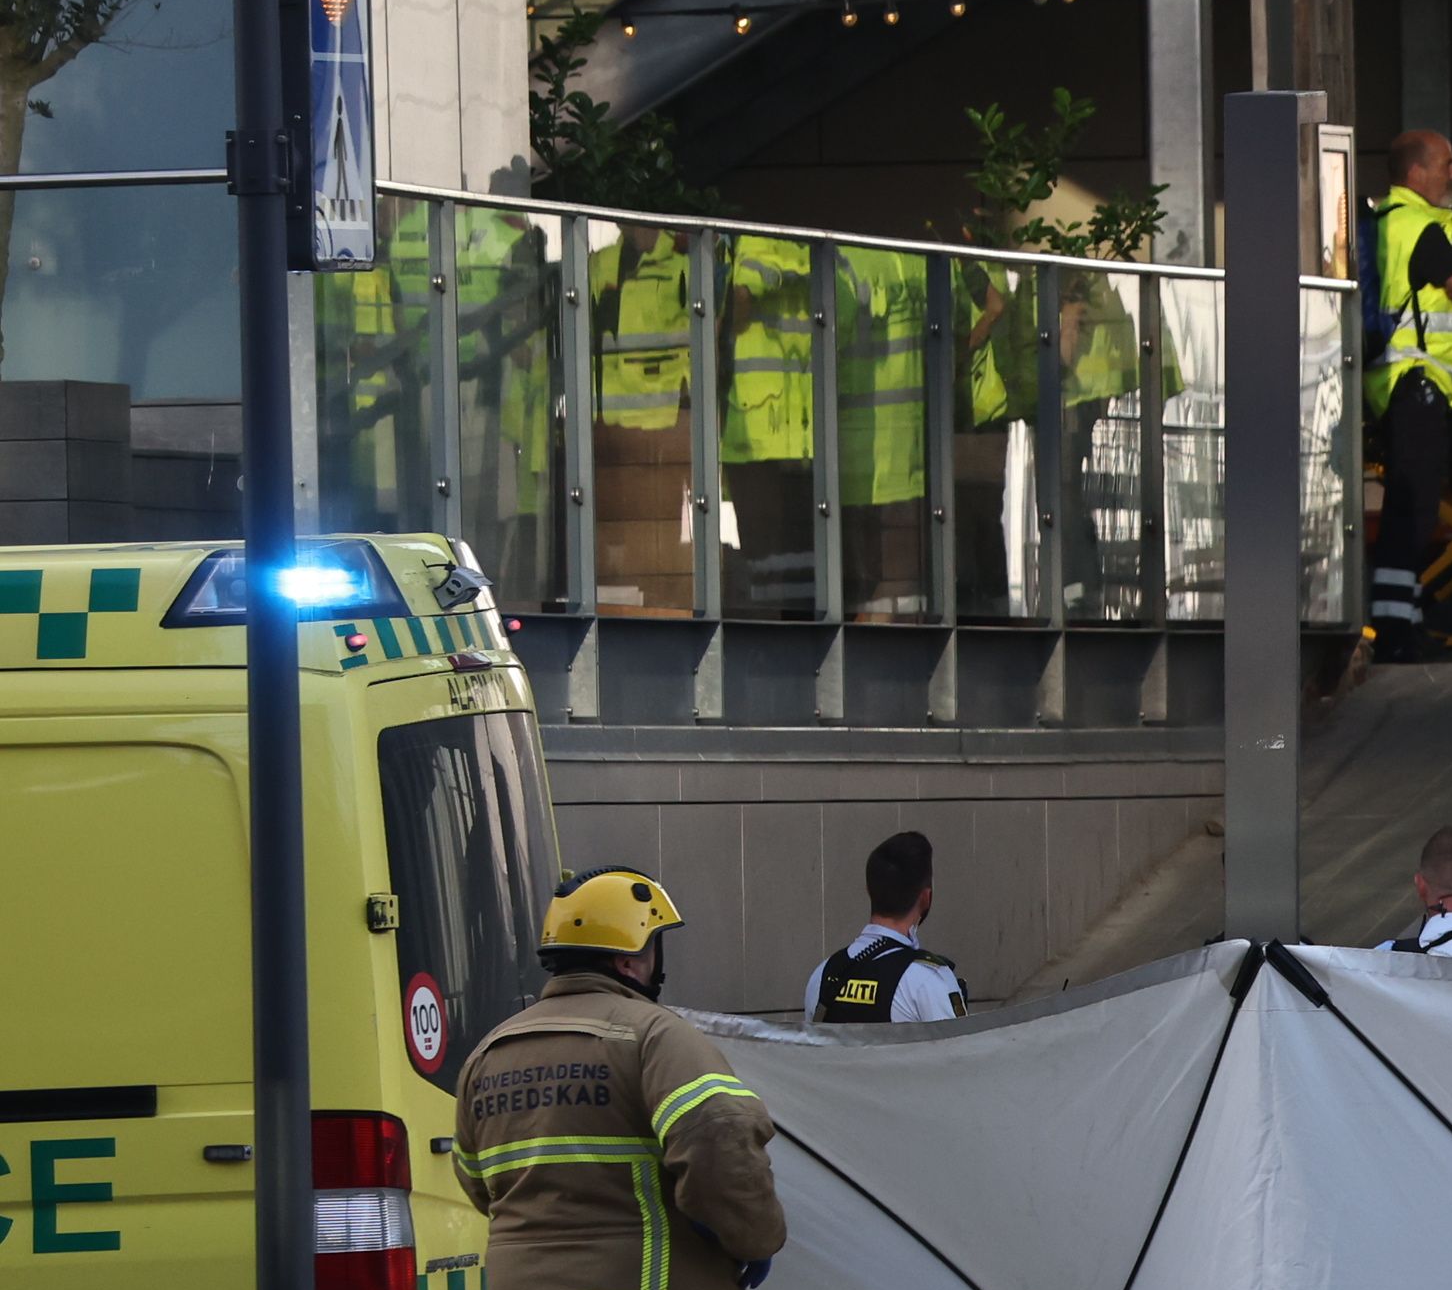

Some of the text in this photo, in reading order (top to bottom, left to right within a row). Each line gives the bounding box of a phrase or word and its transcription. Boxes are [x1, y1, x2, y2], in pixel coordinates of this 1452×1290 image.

[839, 981, 876, 1001] LITI
[411, 1003, 440, 1036] 100
[472, 1063, 610, 1092] HOVEDSTADENS
[472, 1083, 611, 1121] BEREDSKAB
[0, 1137, 121, 1254] E
